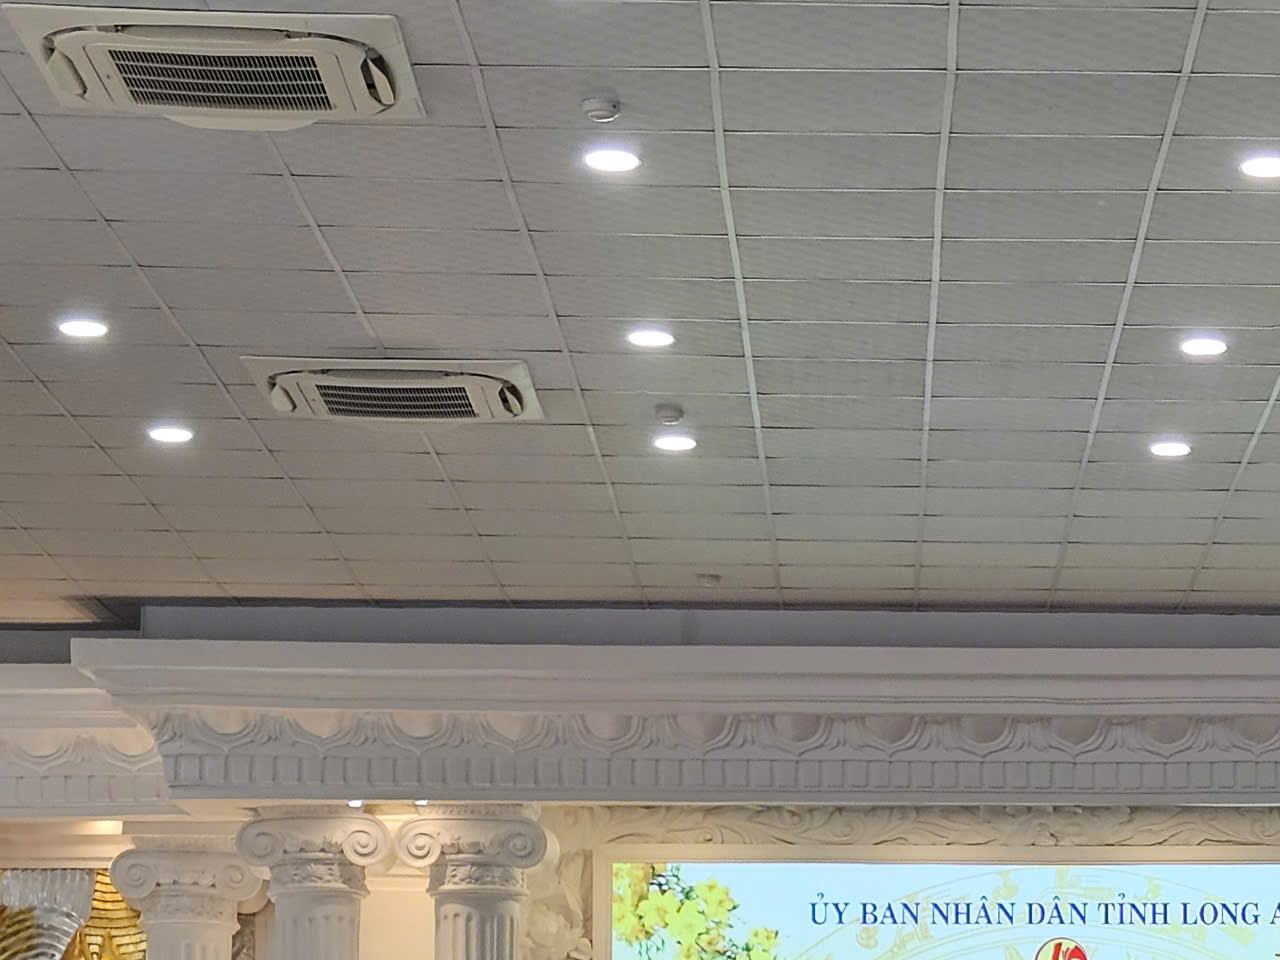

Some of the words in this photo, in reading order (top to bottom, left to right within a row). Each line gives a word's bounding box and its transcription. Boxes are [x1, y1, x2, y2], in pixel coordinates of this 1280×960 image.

[809, 892, 849, 925] ỦY
[859, 902, 920, 925] BAN
[931, 895, 1014, 925] NHÂN
[1026, 895, 1088, 925] DÂN
[1097, 892, 1169, 925] TỈNH
[1180, 902, 1261, 925] LONG
